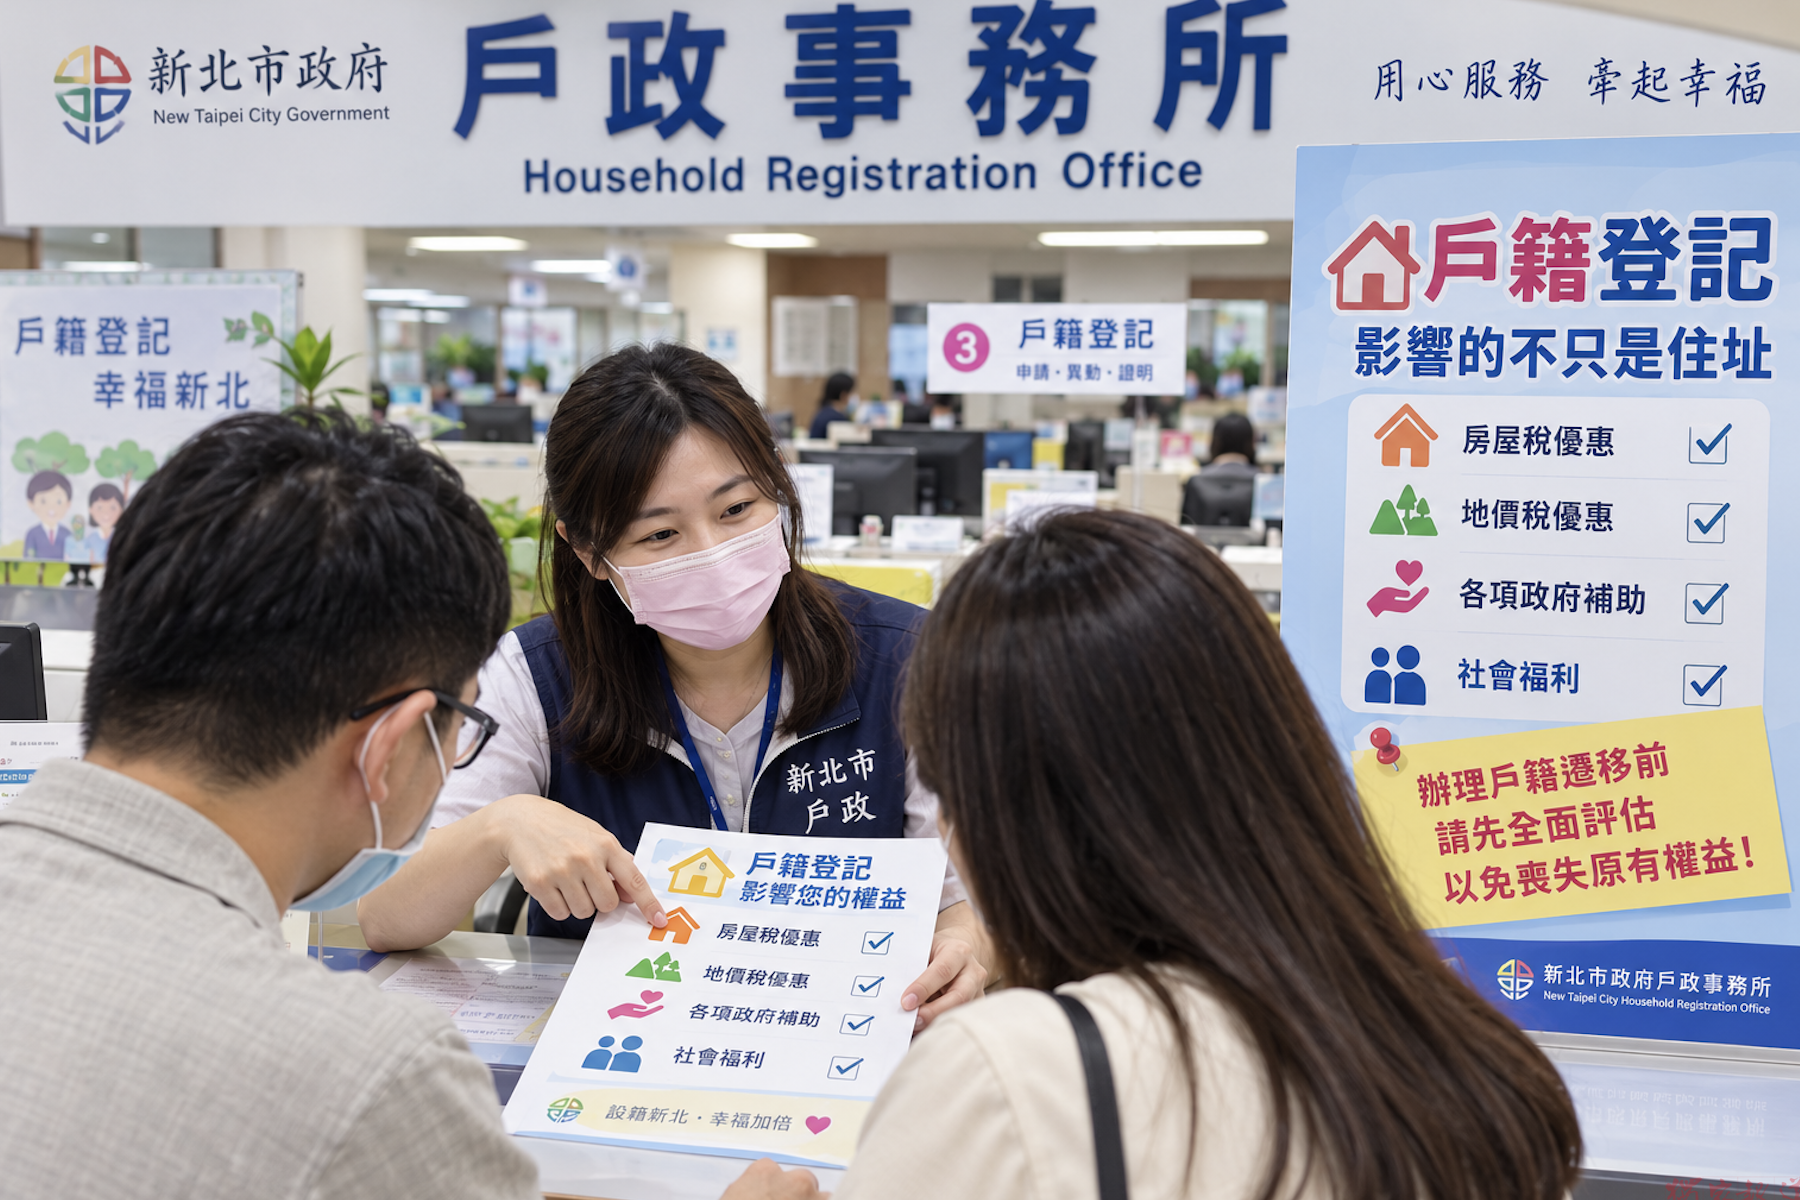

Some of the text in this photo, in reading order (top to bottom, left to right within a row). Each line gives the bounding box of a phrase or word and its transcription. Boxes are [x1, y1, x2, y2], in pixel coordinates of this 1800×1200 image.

[148, 42, 388, 98] 新北市政府
[454, 0, 1288, 141] 戶政事務所
[1374, 57, 1766, 107] 用心服務 牽起幸福
[153, 105, 390, 127] New Taipei City Government
[524, 151, 1203, 199] Household Registration Office
[1424, 215, 1773, 303] 戶籍登記
[15, 316, 171, 356] 戶籍登記
[954, 329, 978, 365] 3
[1018, 318, 1154, 350] 戶籍登記
[1354, 325, 1772, 380] 影響的不只是住址
[94, 370, 250, 410] 幸福新北
[1462, 424, 1615, 457] 房屋稅優惠
[1461, 498, 1614, 532] 地價稅優惠
[1459, 578, 1646, 615] 各項政府補助
[1457, 658, 1579, 694] 社會福利
[786, 748, 876, 794] 新北市
[1417, 741, 1670, 808] 辦理戶籍遷移前
[805, 790, 877, 834] 戶政
[1434, 795, 1657, 856] 請先全面評估
[746, 852, 873, 881] 戶籍登記
[739, 880, 907, 910] 影響您的權益
[717, 923, 822, 947] 房屋稅優惠
[703, 965, 811, 989] 地價稅優惠
[1543, 963, 1772, 999] 新北市政府戶政事務所
[689, 1003, 821, 1028] 各項政府補助
[1543, 990, 1771, 1015] New Taipei City Household Registration Office
[673, 1046, 766, 1069] 社會福利
